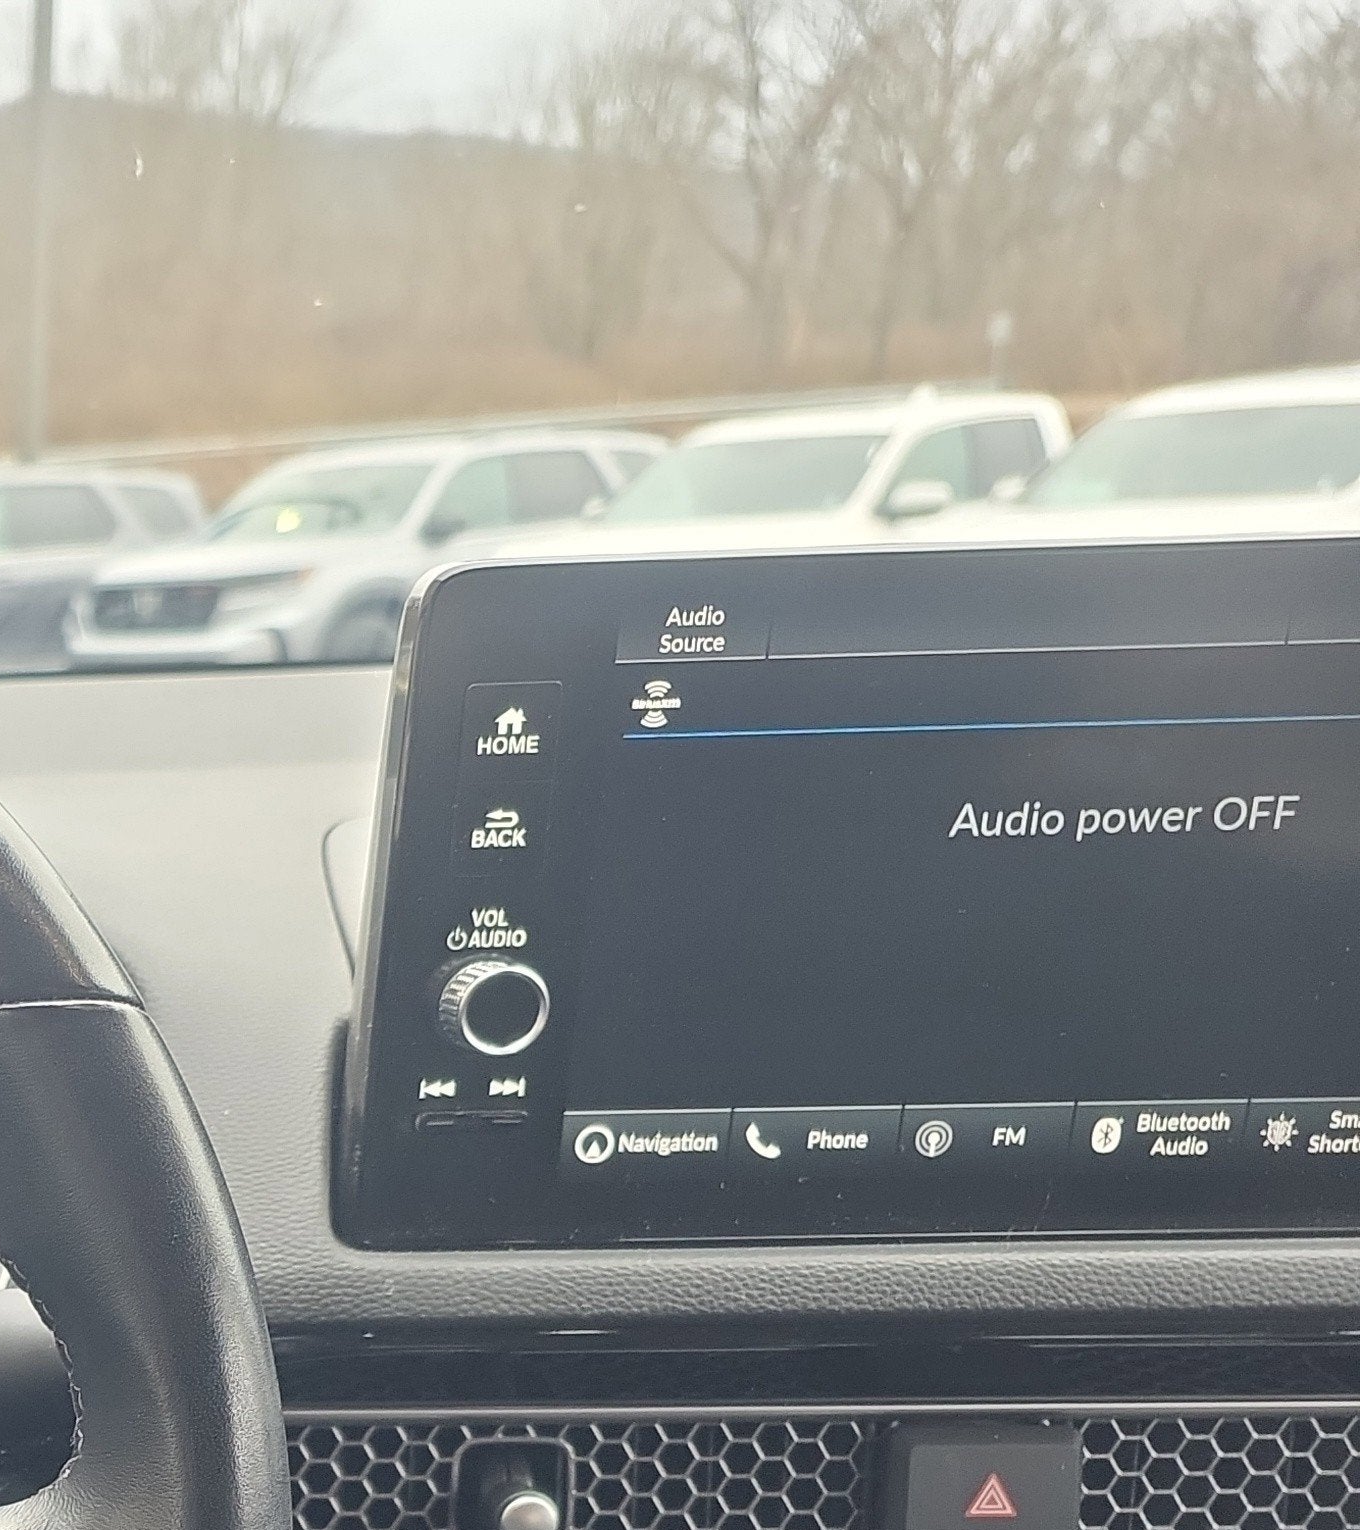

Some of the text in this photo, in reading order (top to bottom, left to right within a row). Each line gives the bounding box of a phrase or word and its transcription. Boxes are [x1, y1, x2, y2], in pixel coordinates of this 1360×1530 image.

[665, 605, 725, 627] Audio
[658, 634, 725, 654] Source
[476, 735, 540, 756] HOME
[948, 795, 1301, 842] Audio power OFF
[471, 828, 527, 848] BACK
[471, 908, 508, 927] VOL
[468, 928, 527, 948] AUDIO
[1136, 1111, 1231, 1133] Bluetooth
[1329, 1109, 1360, 1130] Sm
[617, 1131, 718, 1156] Navigation
[806, 1128, 869, 1150] Phone
[992, 1126, 1027, 1147] FM
[1150, 1135, 1209, 1157] Audio
[1307, 1132, 1360, 1154] Short
